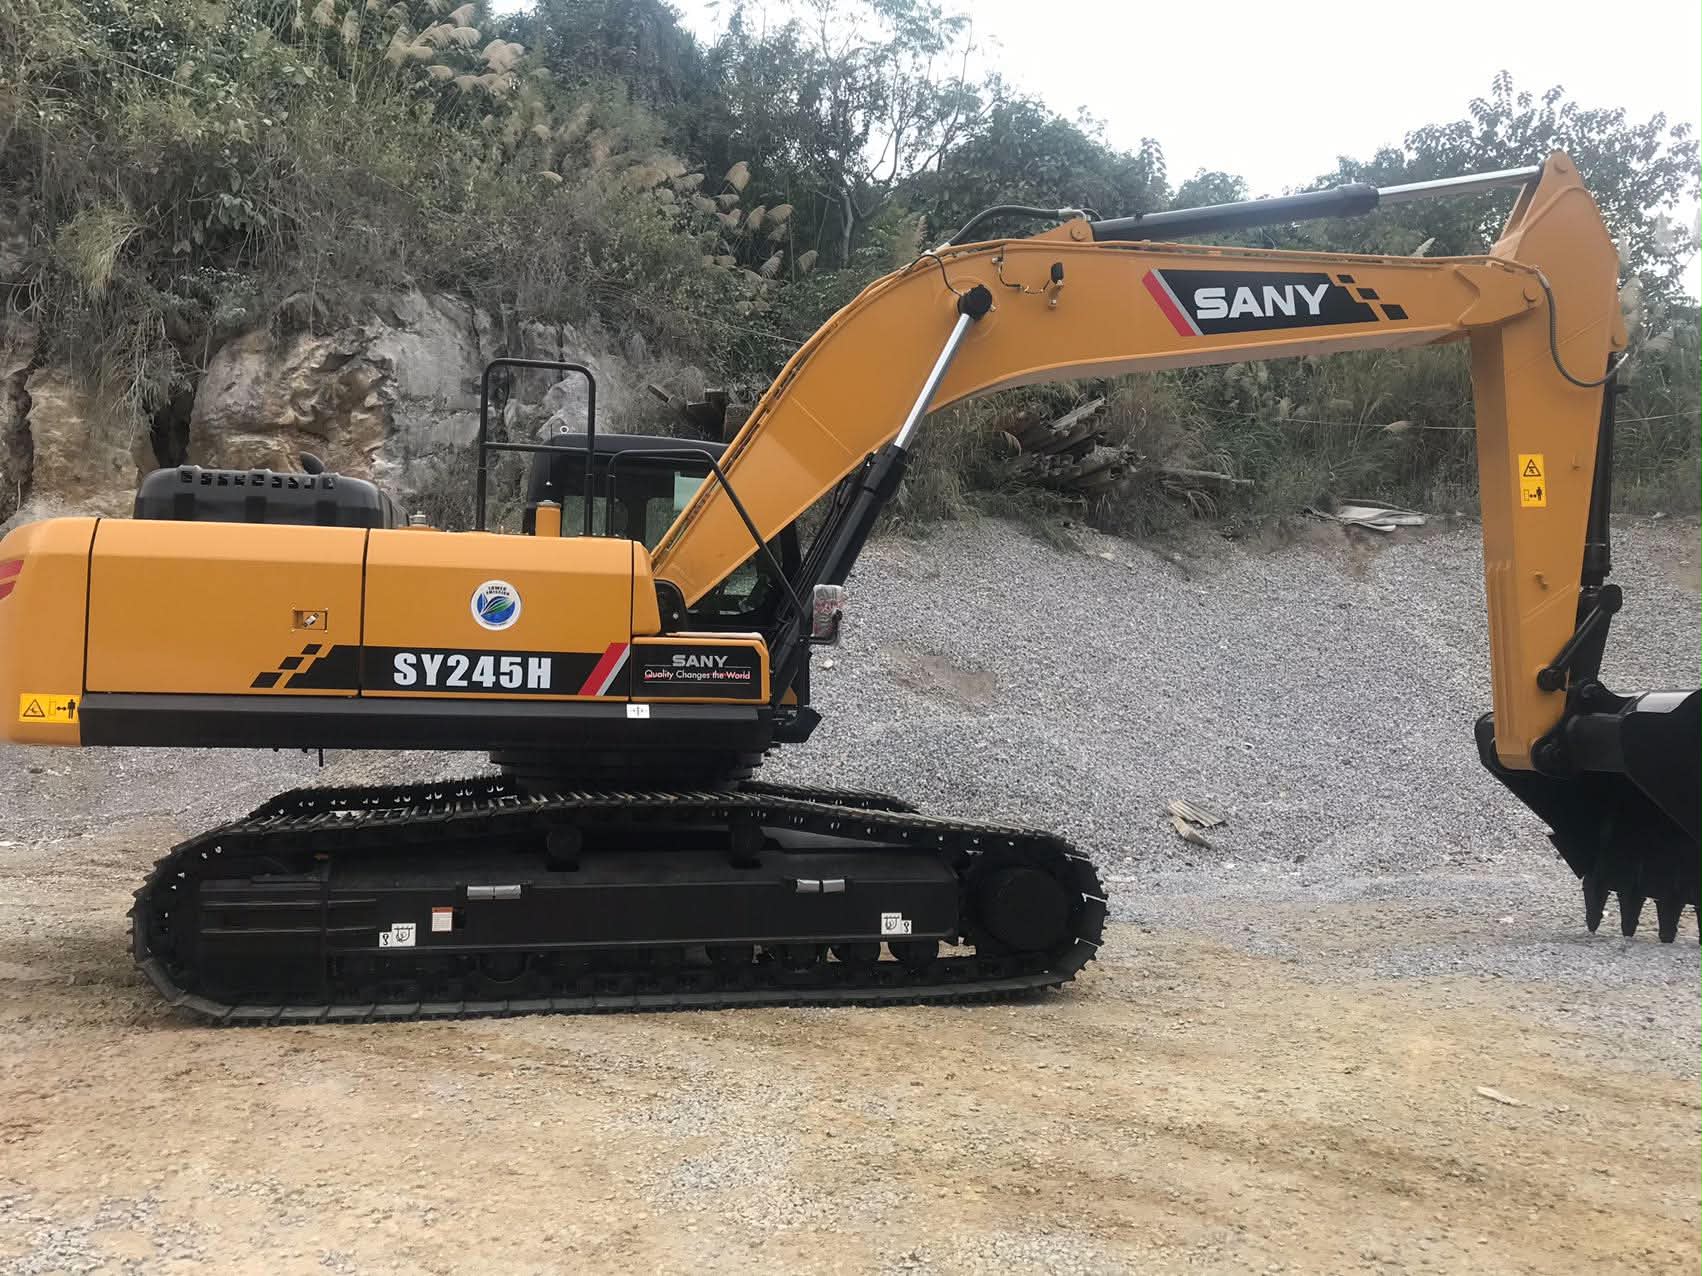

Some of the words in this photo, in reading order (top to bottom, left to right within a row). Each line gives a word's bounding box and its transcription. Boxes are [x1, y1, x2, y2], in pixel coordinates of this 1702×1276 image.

[1193, 283, 1329, 319] SANY
[393, 652, 552, 689] SY245H
[672, 654, 729, 668] SANY
[644, 669, 674, 680] Quality
[675, 670, 710, 681] Changes
[712, 670, 724, 680] the
[726, 671, 751, 680] World
